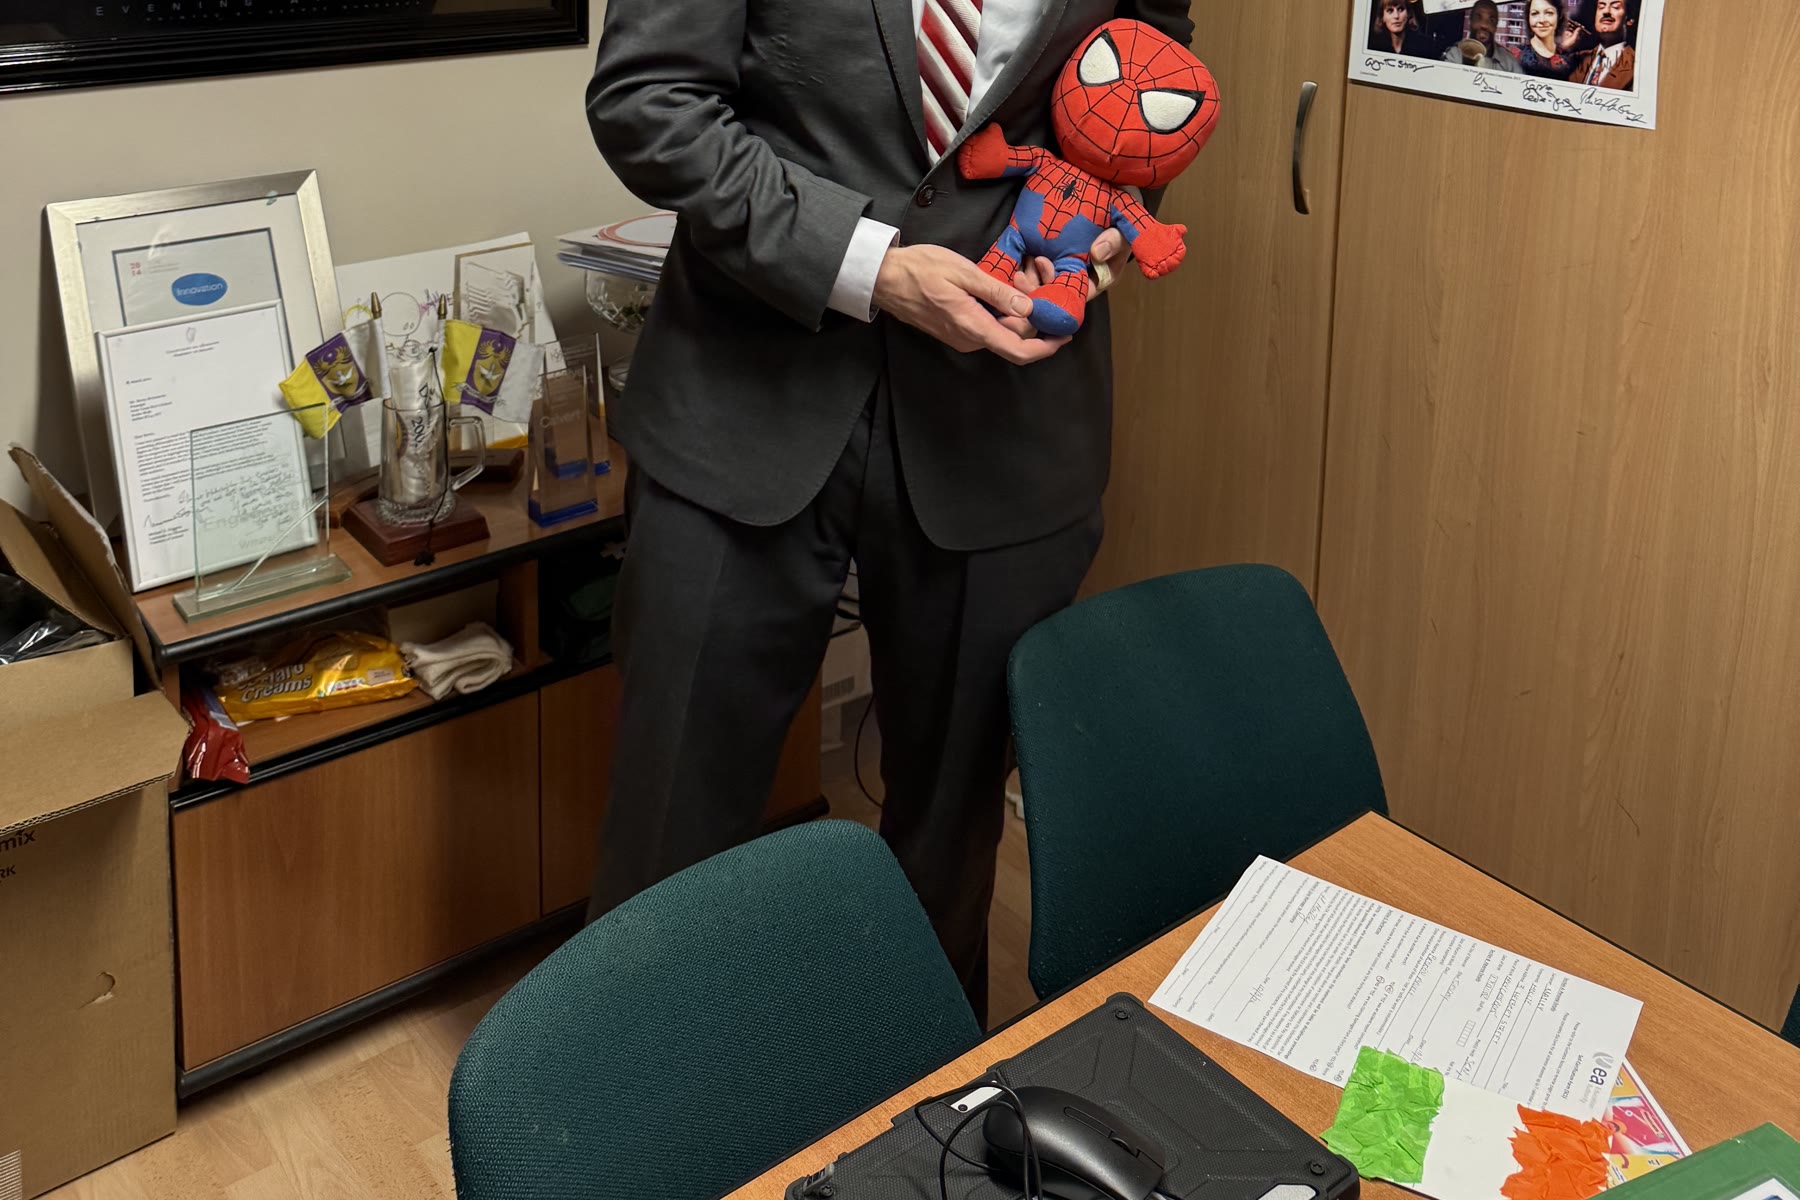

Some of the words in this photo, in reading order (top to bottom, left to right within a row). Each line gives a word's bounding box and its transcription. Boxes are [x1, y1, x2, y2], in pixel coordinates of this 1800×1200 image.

[176, 282, 223, 296] Innovation
[241, 674, 312, 702] Creams
[1490, 1018, 1508, 1045] STREET
[1589, 1067, 1607, 1086] ea
